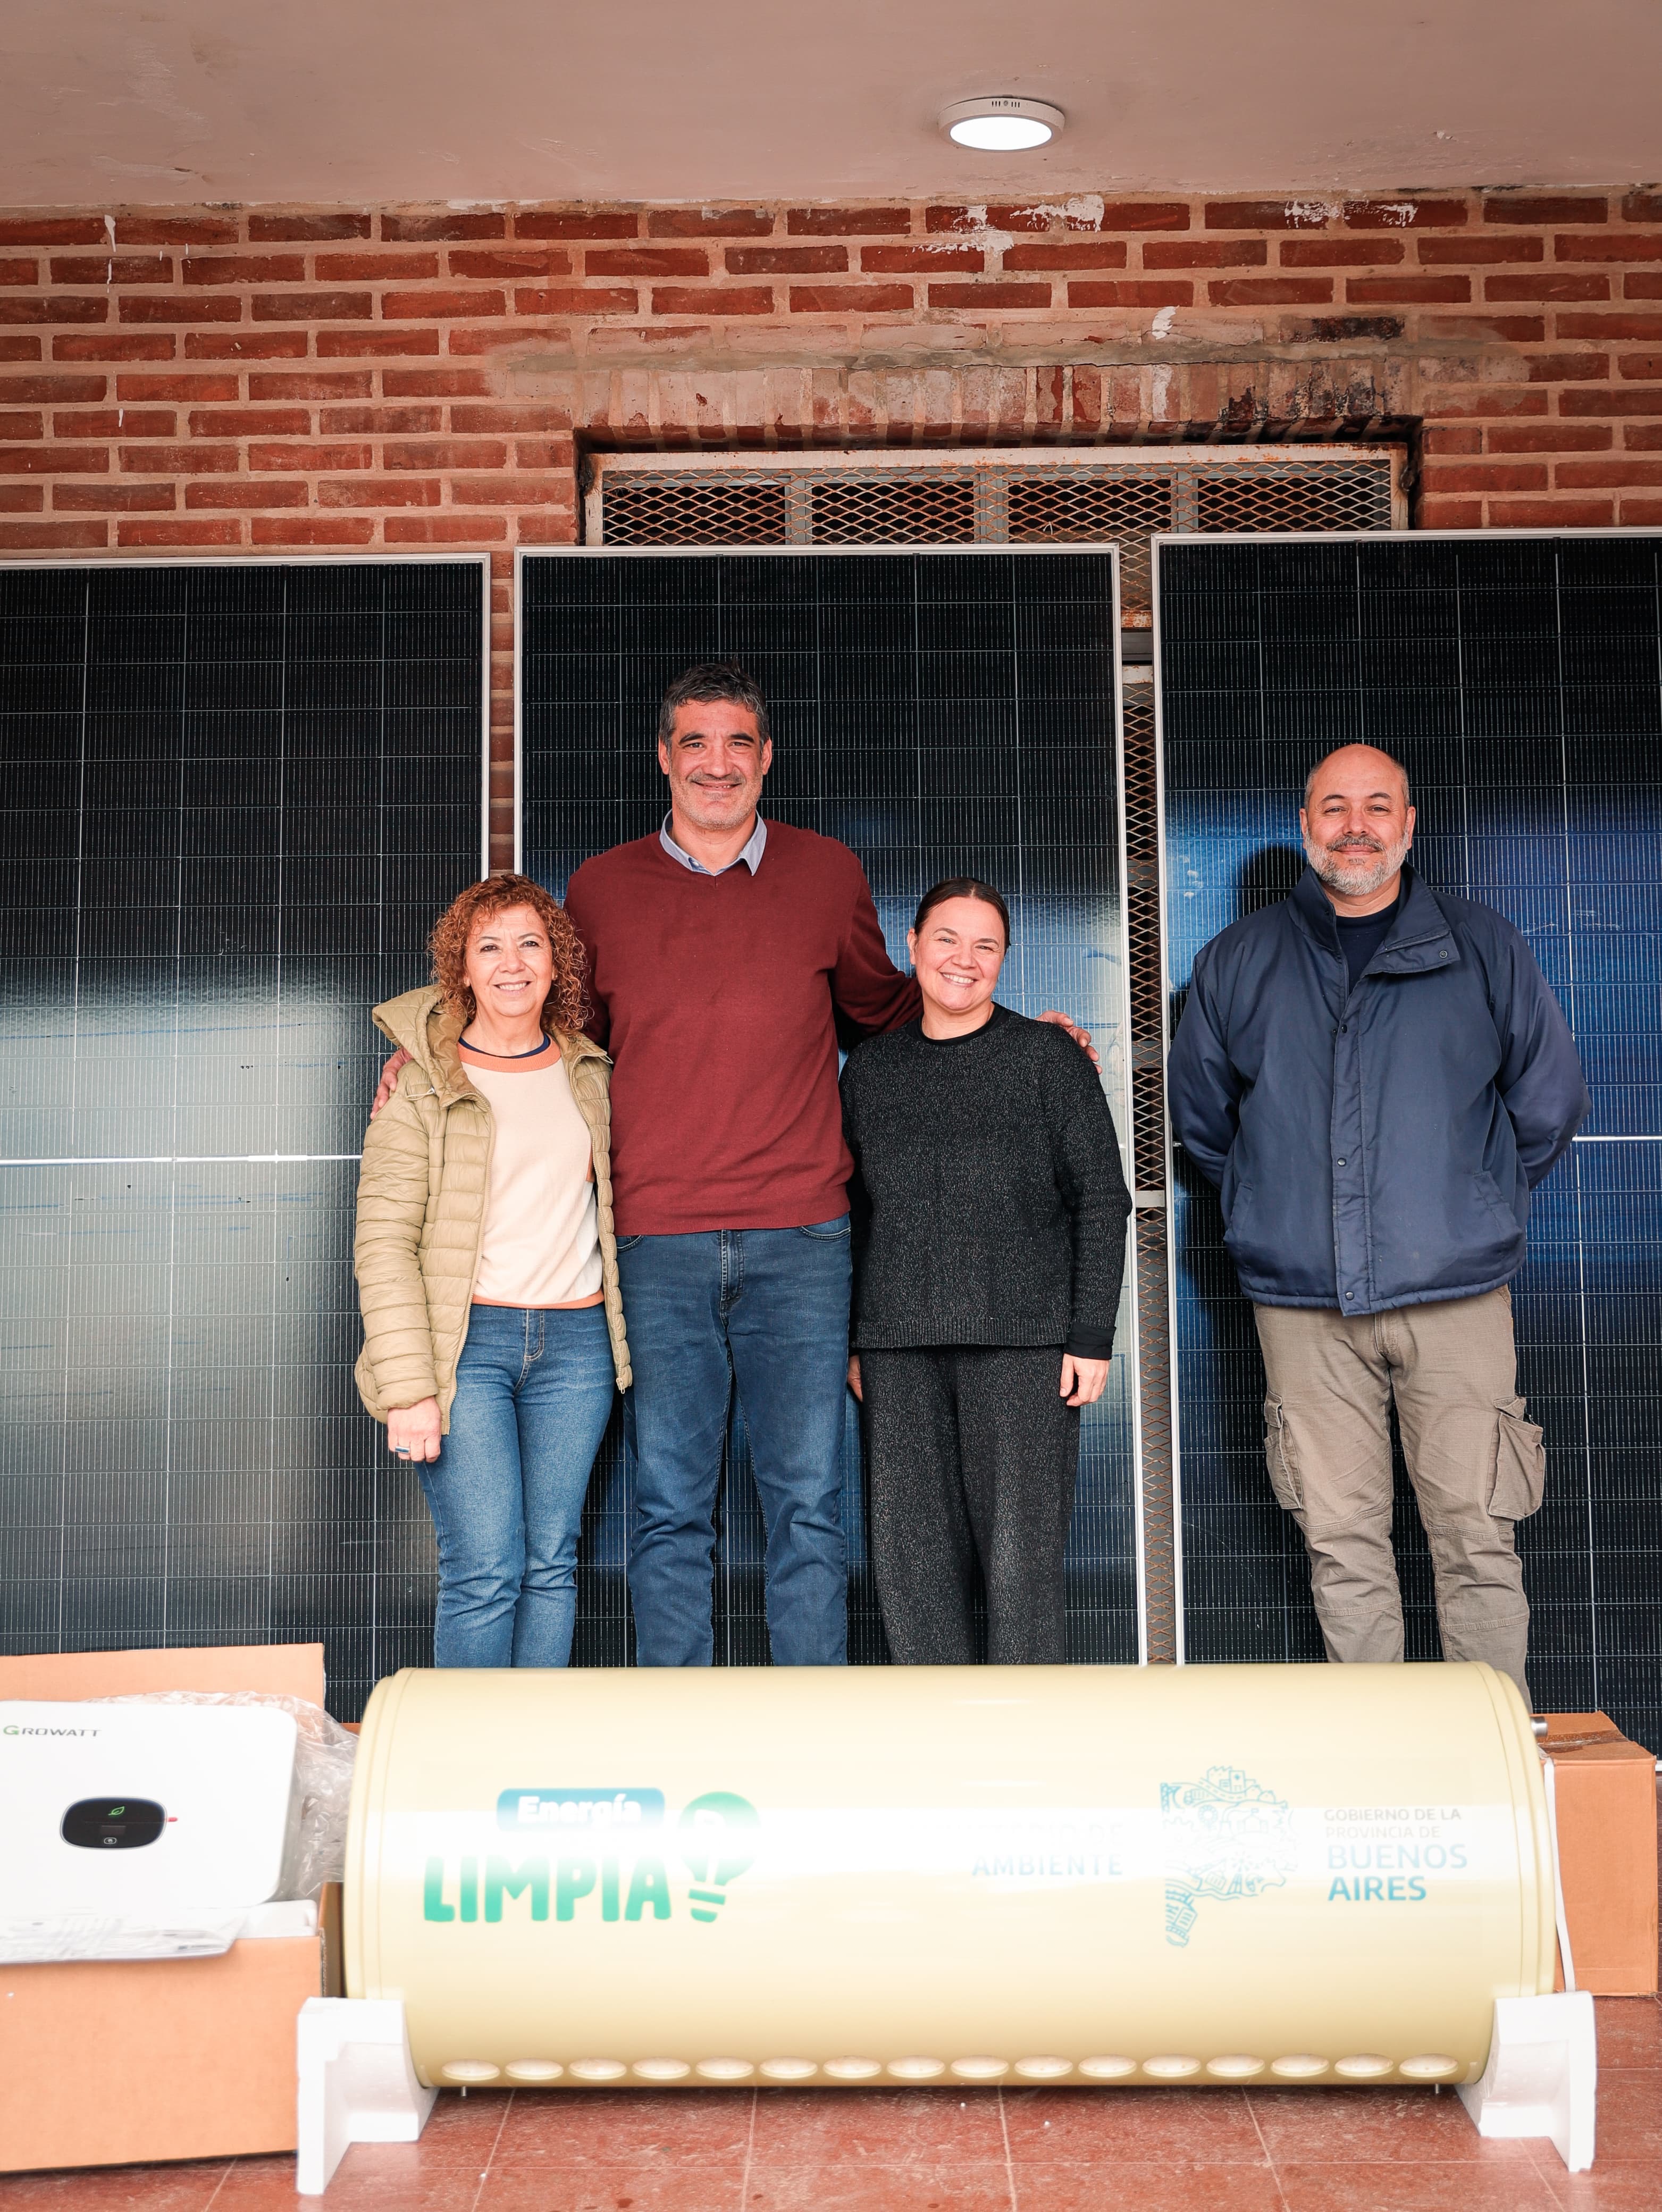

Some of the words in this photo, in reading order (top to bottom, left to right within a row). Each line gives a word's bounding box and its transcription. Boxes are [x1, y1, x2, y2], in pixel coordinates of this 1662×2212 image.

[3, 1725, 102, 1737] GROWATT
[517, 1794, 642, 1829] Energía
[1324, 1809, 1409, 1821] GOBIERNO
[1414, 1809, 1436, 1821] DE
[1441, 1808, 1462, 1820] LA
[1326, 1826, 1414, 1838] PROVINCIA
[1420, 1826, 1441, 1838] DE
[971, 1854, 1123, 1876] AMBIENTE
[1328, 1844, 1468, 1870] BUENOS
[424, 1854, 671, 1923] LIMPIA
[1327, 1875, 1428, 1901] AIRES
